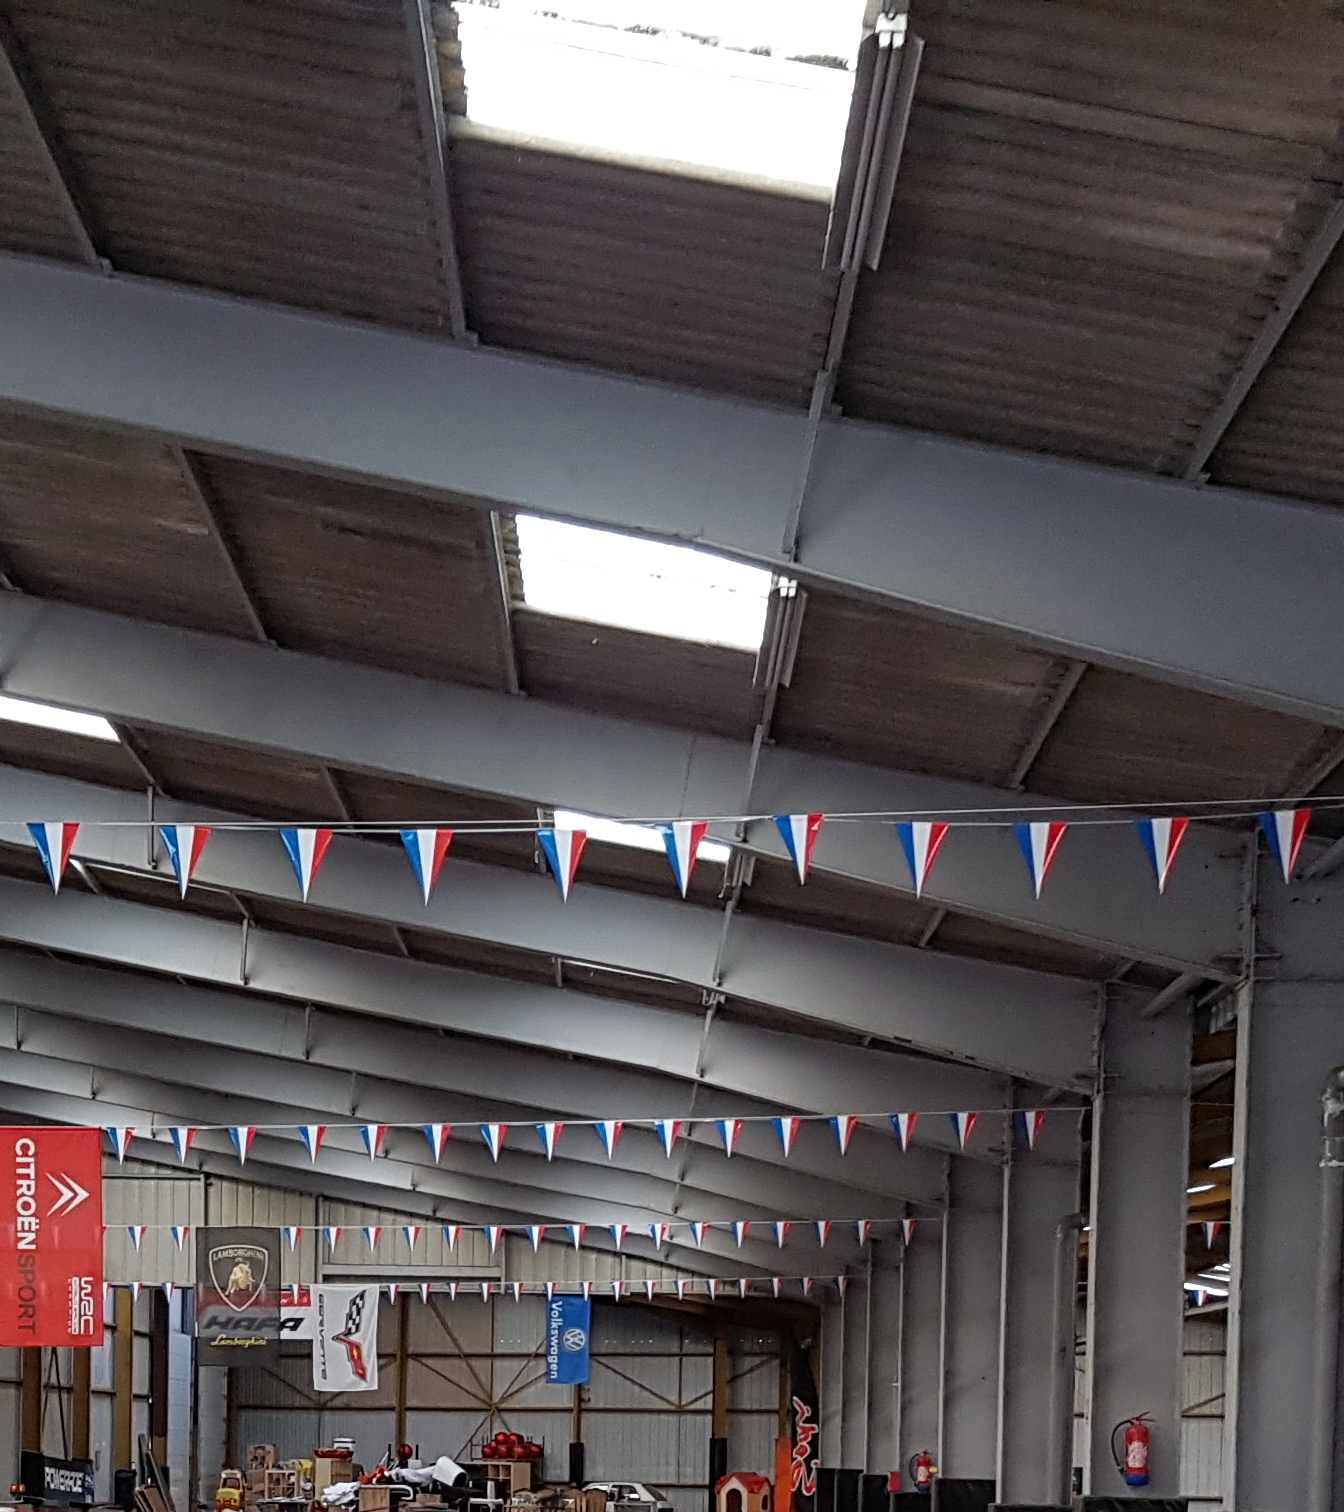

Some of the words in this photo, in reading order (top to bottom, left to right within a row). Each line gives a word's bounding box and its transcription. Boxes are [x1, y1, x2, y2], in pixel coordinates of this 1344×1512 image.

[15, 1138, 40, 1250] CITROËN
[17, 1253, 36, 1334] SPORT
[80, 1277, 94, 1335] WRC
[211, 1334, 267, 1348] Lamborghini
[547, 1301, 563, 1379] Volkswagen
